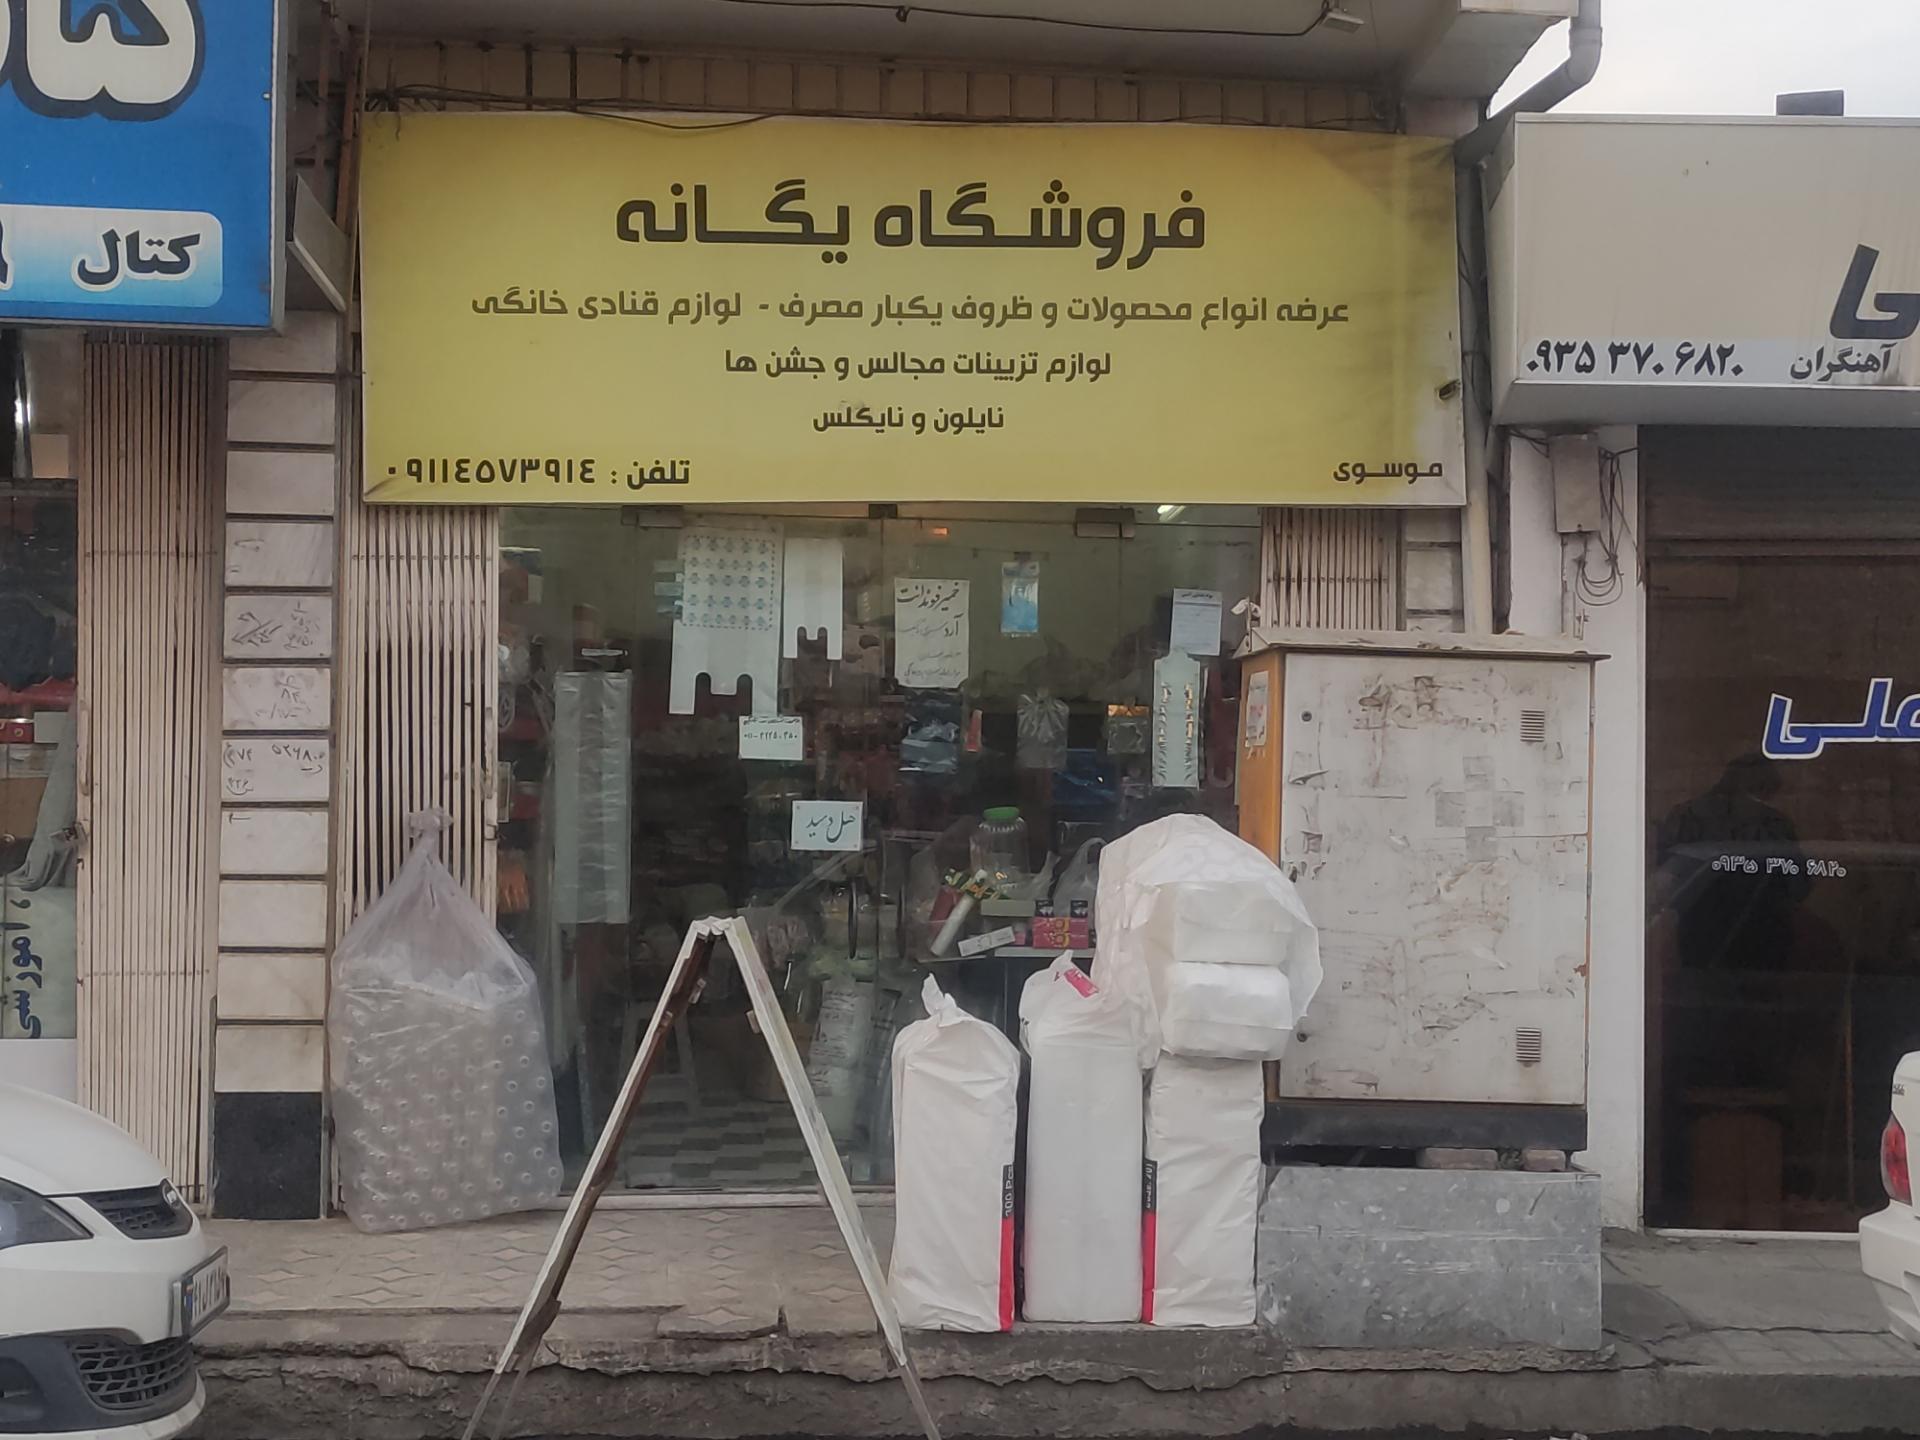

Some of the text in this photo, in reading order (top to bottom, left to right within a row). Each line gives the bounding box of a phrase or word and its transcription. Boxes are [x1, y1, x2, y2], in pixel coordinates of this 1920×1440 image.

[617, 179, 1205, 270] فروشگاه یگانه
[78, 229, 200, 285] کتال
[472, 287, 568, 314] خانگی
[578, 291, 658, 319] قنادی
[669, 292, 740, 325] لوازم
[779, 293, 863, 326] مصرف
[871, 295, 942, 327] یکبار
[952, 295, 1032, 328] ظروف
[1042, 303, 1057, 328] و
[1068, 296, 1191, 327] محصولات
[1201, 297, 1266, 330] انواع
[1277, 298, 1349, 330] عرضه
[726, 346, 1110, 382] لوازم تزیینات مجالس و جشن ها
[1790, 342, 1898, 382] آهنگران
[813, 407, 1003, 435] نایلون و نایکلس
[627, 460, 690, 490] تلفن
[1334, 460, 1442, 484] موسوی
